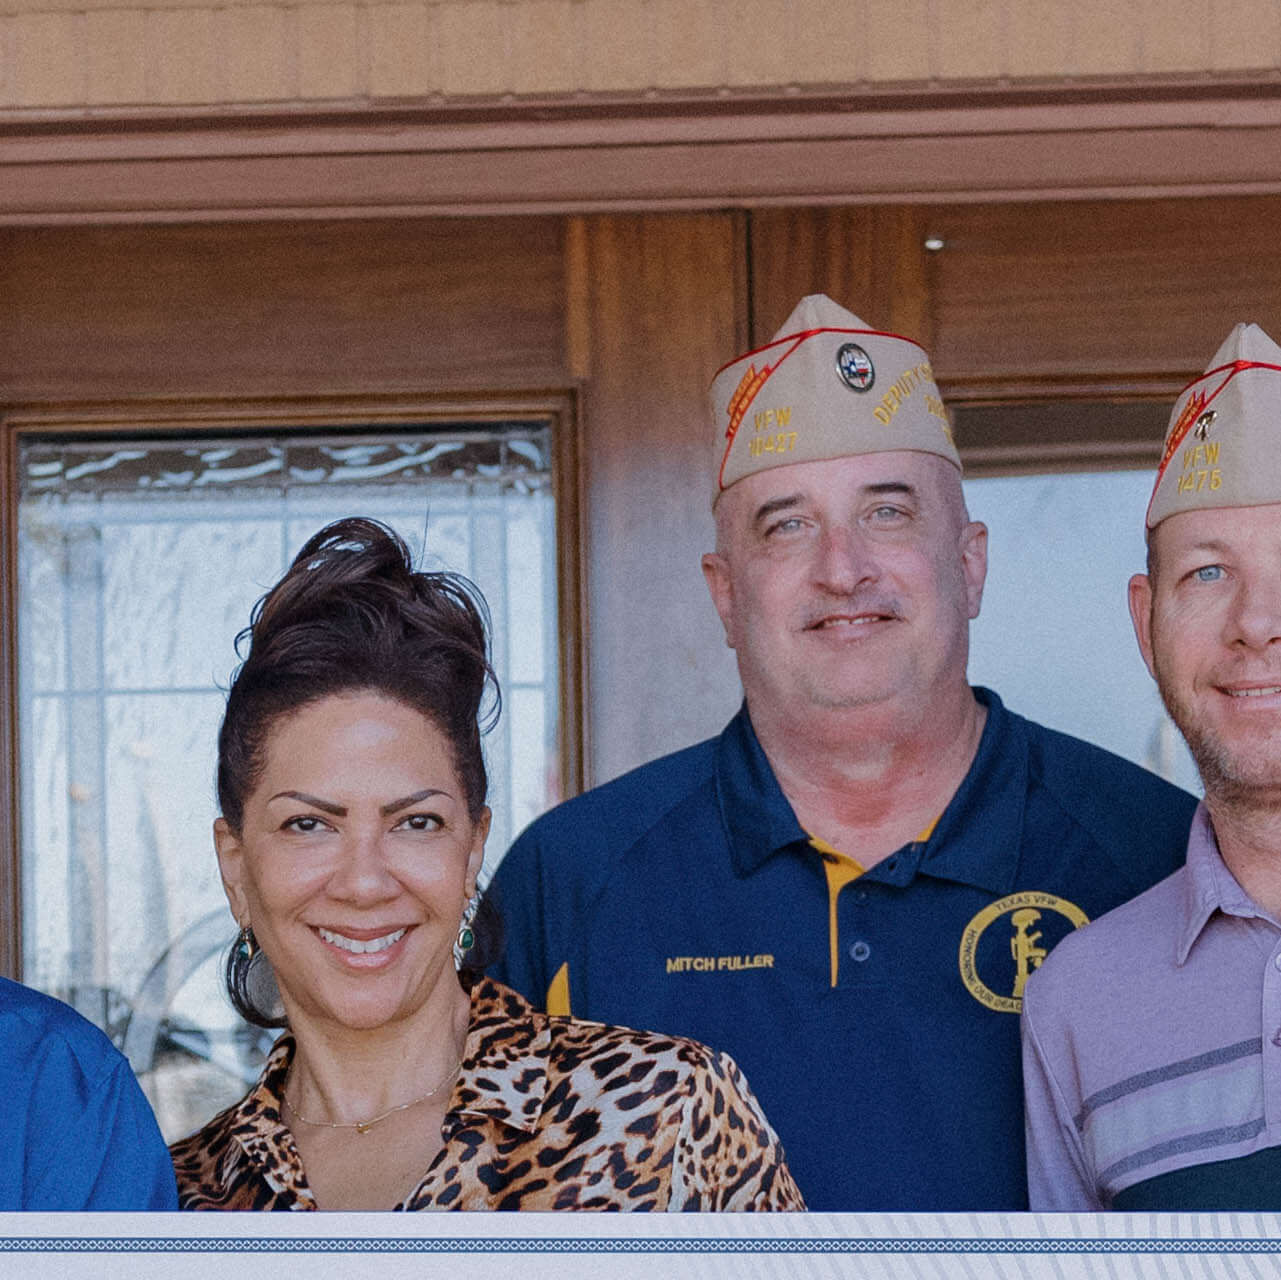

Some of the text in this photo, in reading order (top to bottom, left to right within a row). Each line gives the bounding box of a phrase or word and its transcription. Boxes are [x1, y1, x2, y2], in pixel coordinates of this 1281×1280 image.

[754, 406, 792, 432] VFW
[1183, 441, 1220, 469] VFW
[1178, 468, 1222, 494] 1475
[996, 895, 1031, 911] TEXAS
[666, 953, 775, 974] MITCH FULLER
